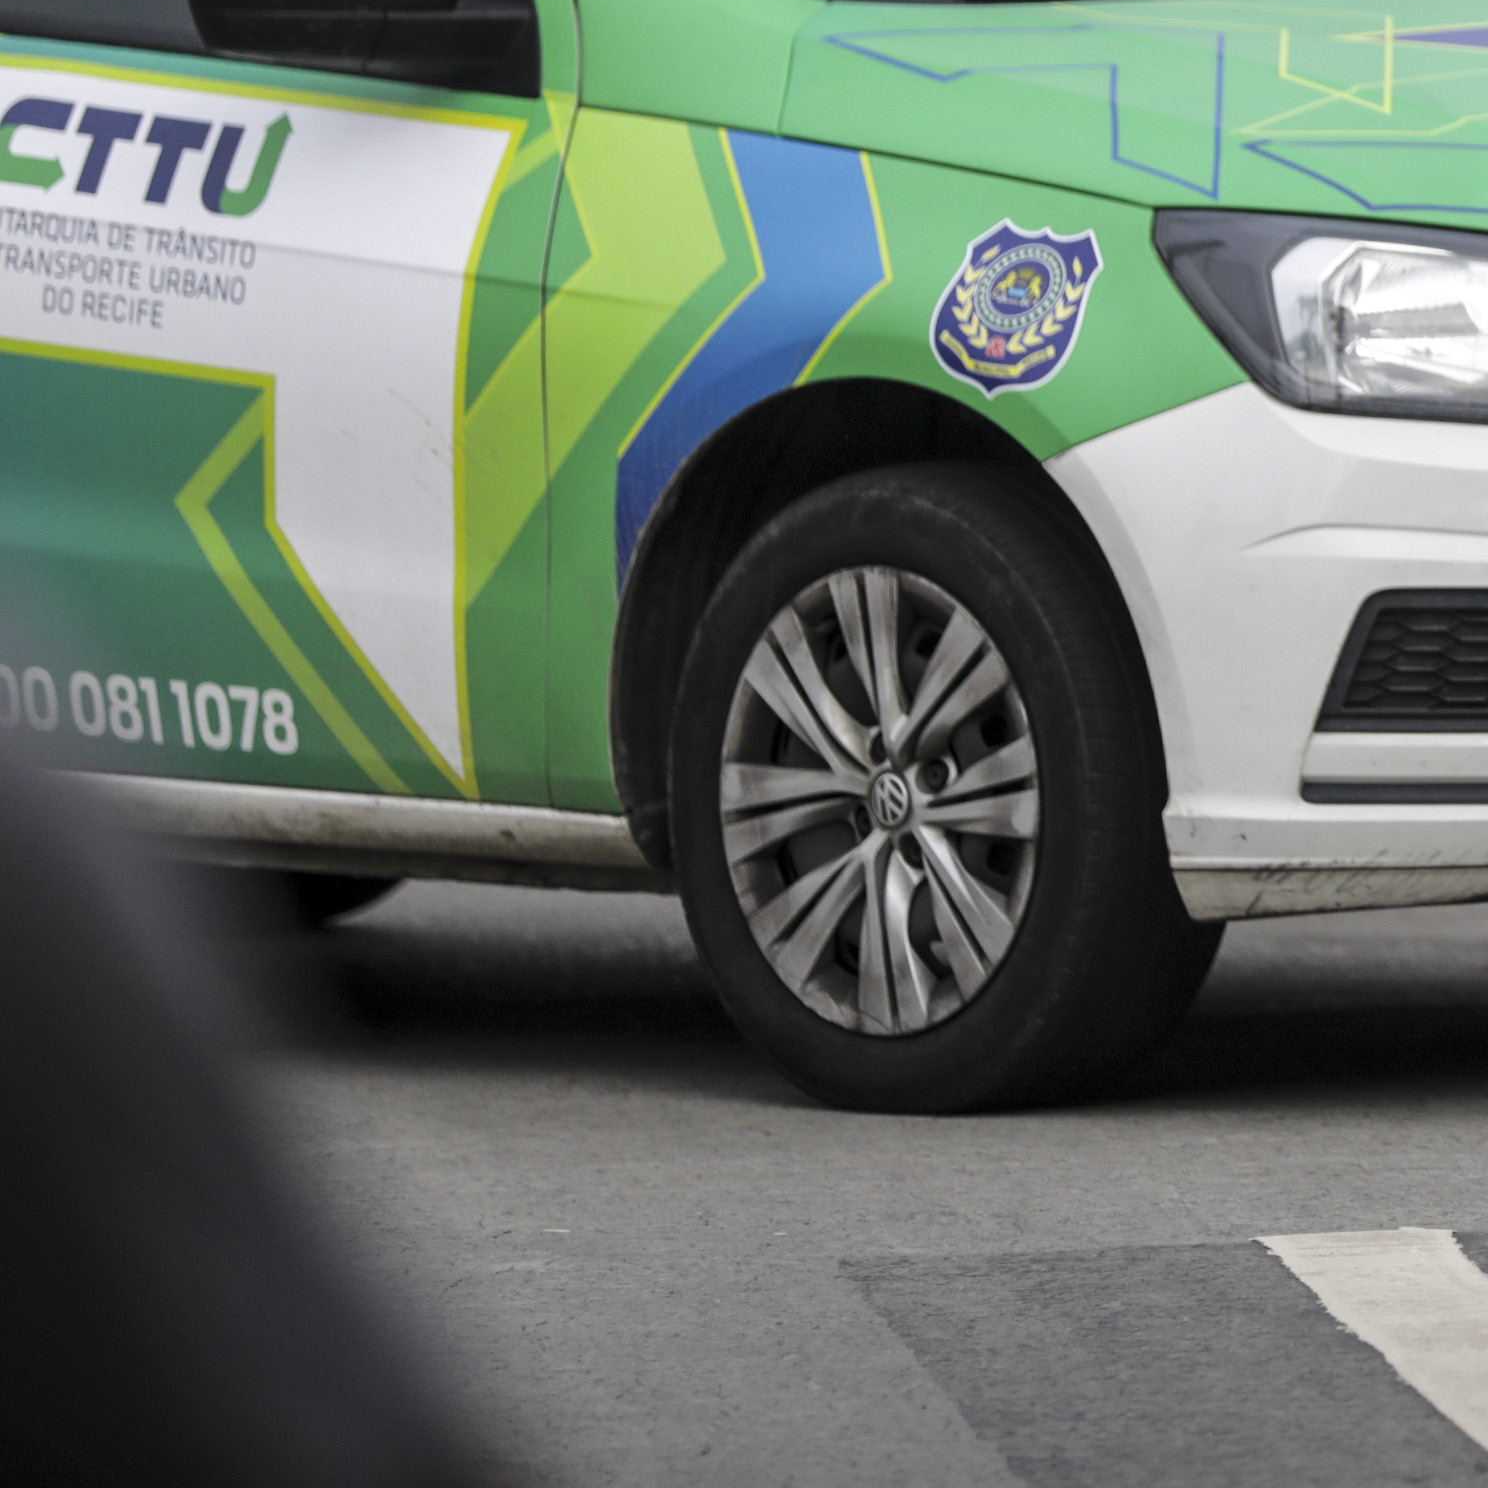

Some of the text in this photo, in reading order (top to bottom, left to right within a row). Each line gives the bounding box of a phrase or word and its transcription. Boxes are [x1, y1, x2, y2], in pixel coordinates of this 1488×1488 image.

[0, 97, 293, 219] CTTU
[0, 208, 257, 270] TARQUIA DE TRÂNSITO
[41, 284, 165, 330] DO RECIFE
[149, 264, 248, 305] URBANO
